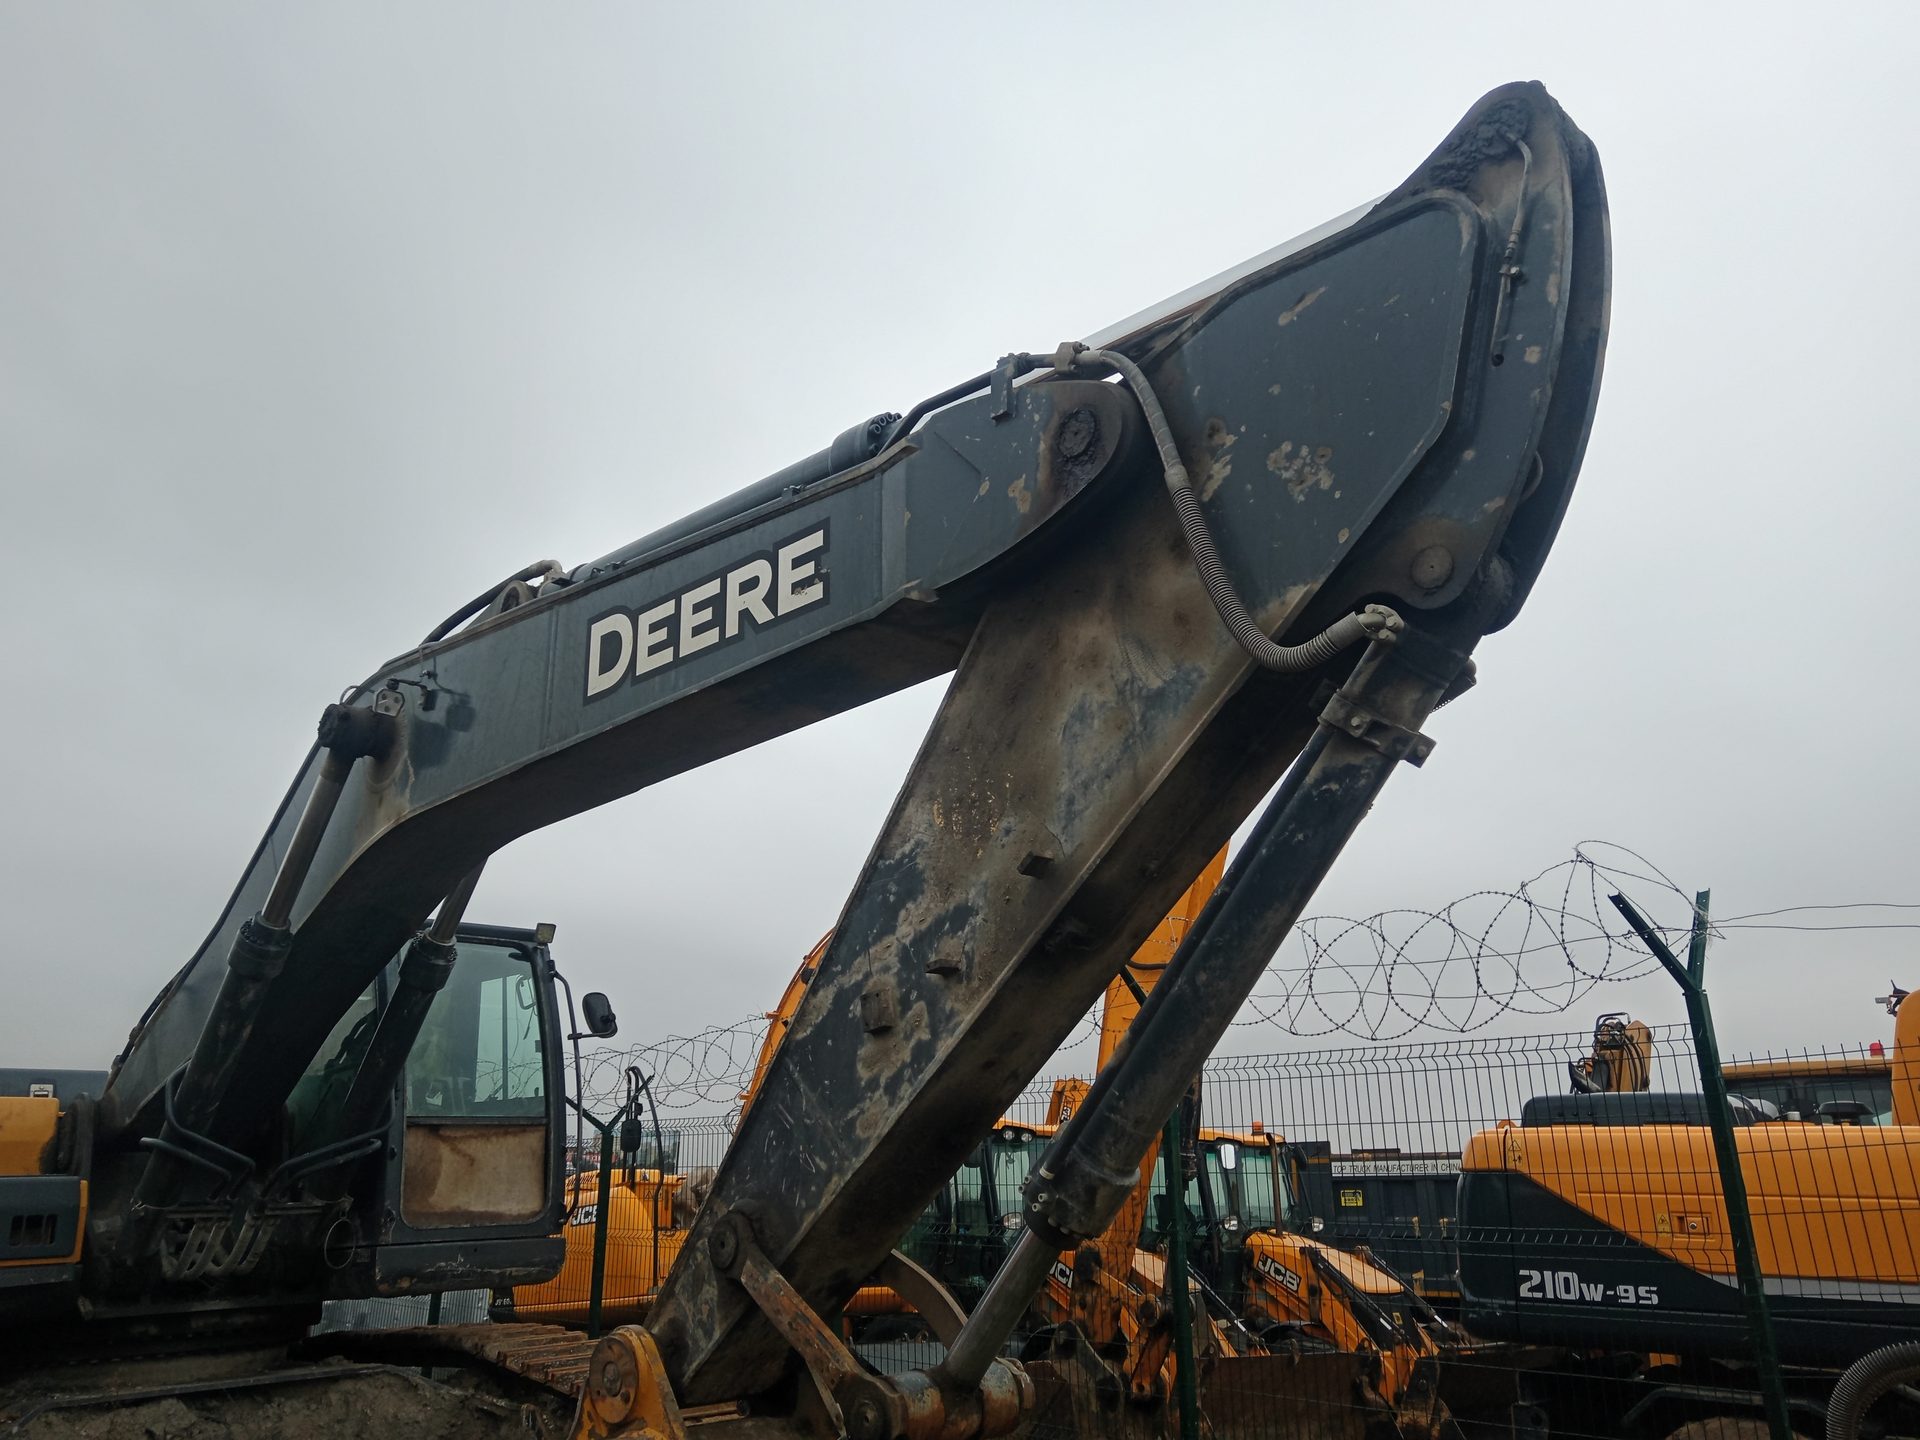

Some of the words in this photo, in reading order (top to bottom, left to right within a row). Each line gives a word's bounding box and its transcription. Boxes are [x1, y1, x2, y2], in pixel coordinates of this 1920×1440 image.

[587, 529, 824, 697] DEERE
[1333, 1165, 1347, 1174] TOP
[1349, 1164, 1371, 1173] TRUCK
[1373, 1163, 1429, 1173] MANUFACTURER
[1430, 1162, 1438, 1172] IN
[1257, 1254, 1300, 1291] JCB
